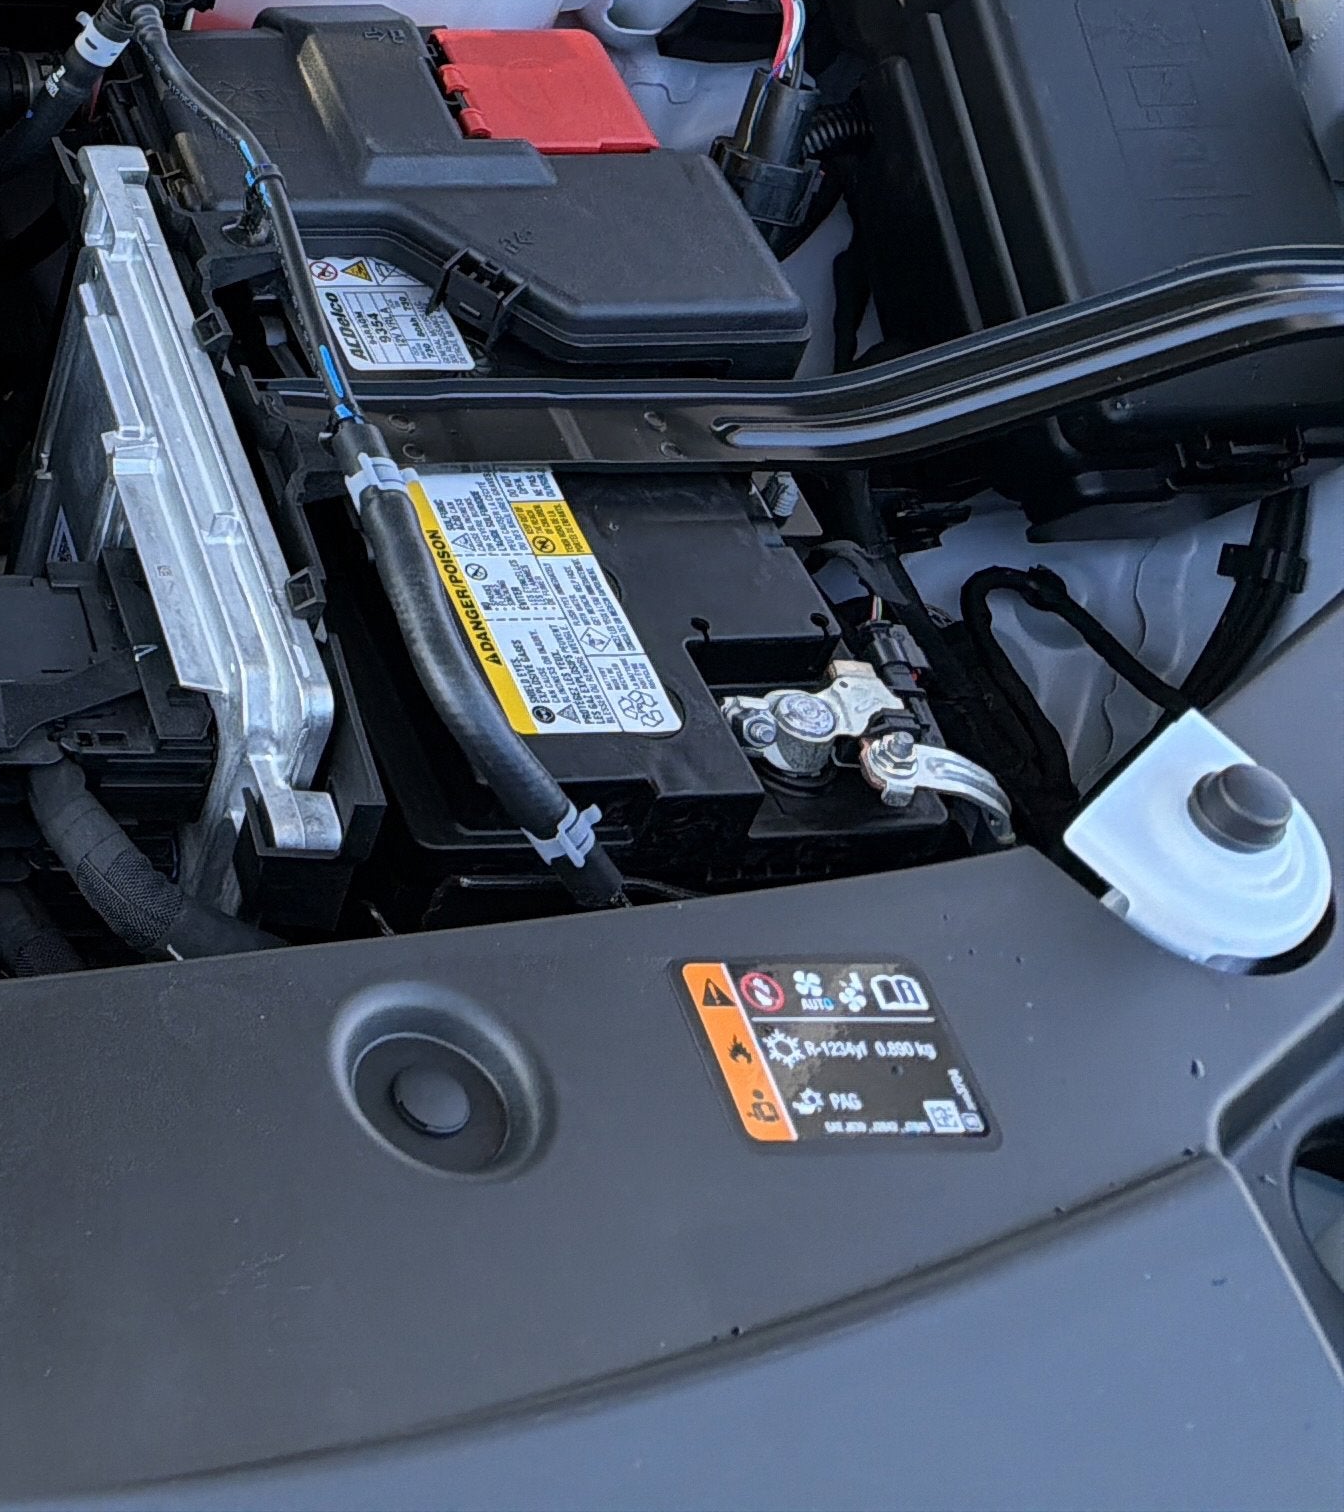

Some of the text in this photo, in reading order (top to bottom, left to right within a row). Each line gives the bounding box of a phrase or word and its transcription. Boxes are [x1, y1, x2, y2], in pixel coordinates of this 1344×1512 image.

[325, 292, 369, 362] ACDelco
[367, 312, 391, 343] 9354
[426, 529, 499, 655] DANGER/POISON
[801, 998, 834, 1010] AUTO
[829, 1092, 862, 1111] PAG
